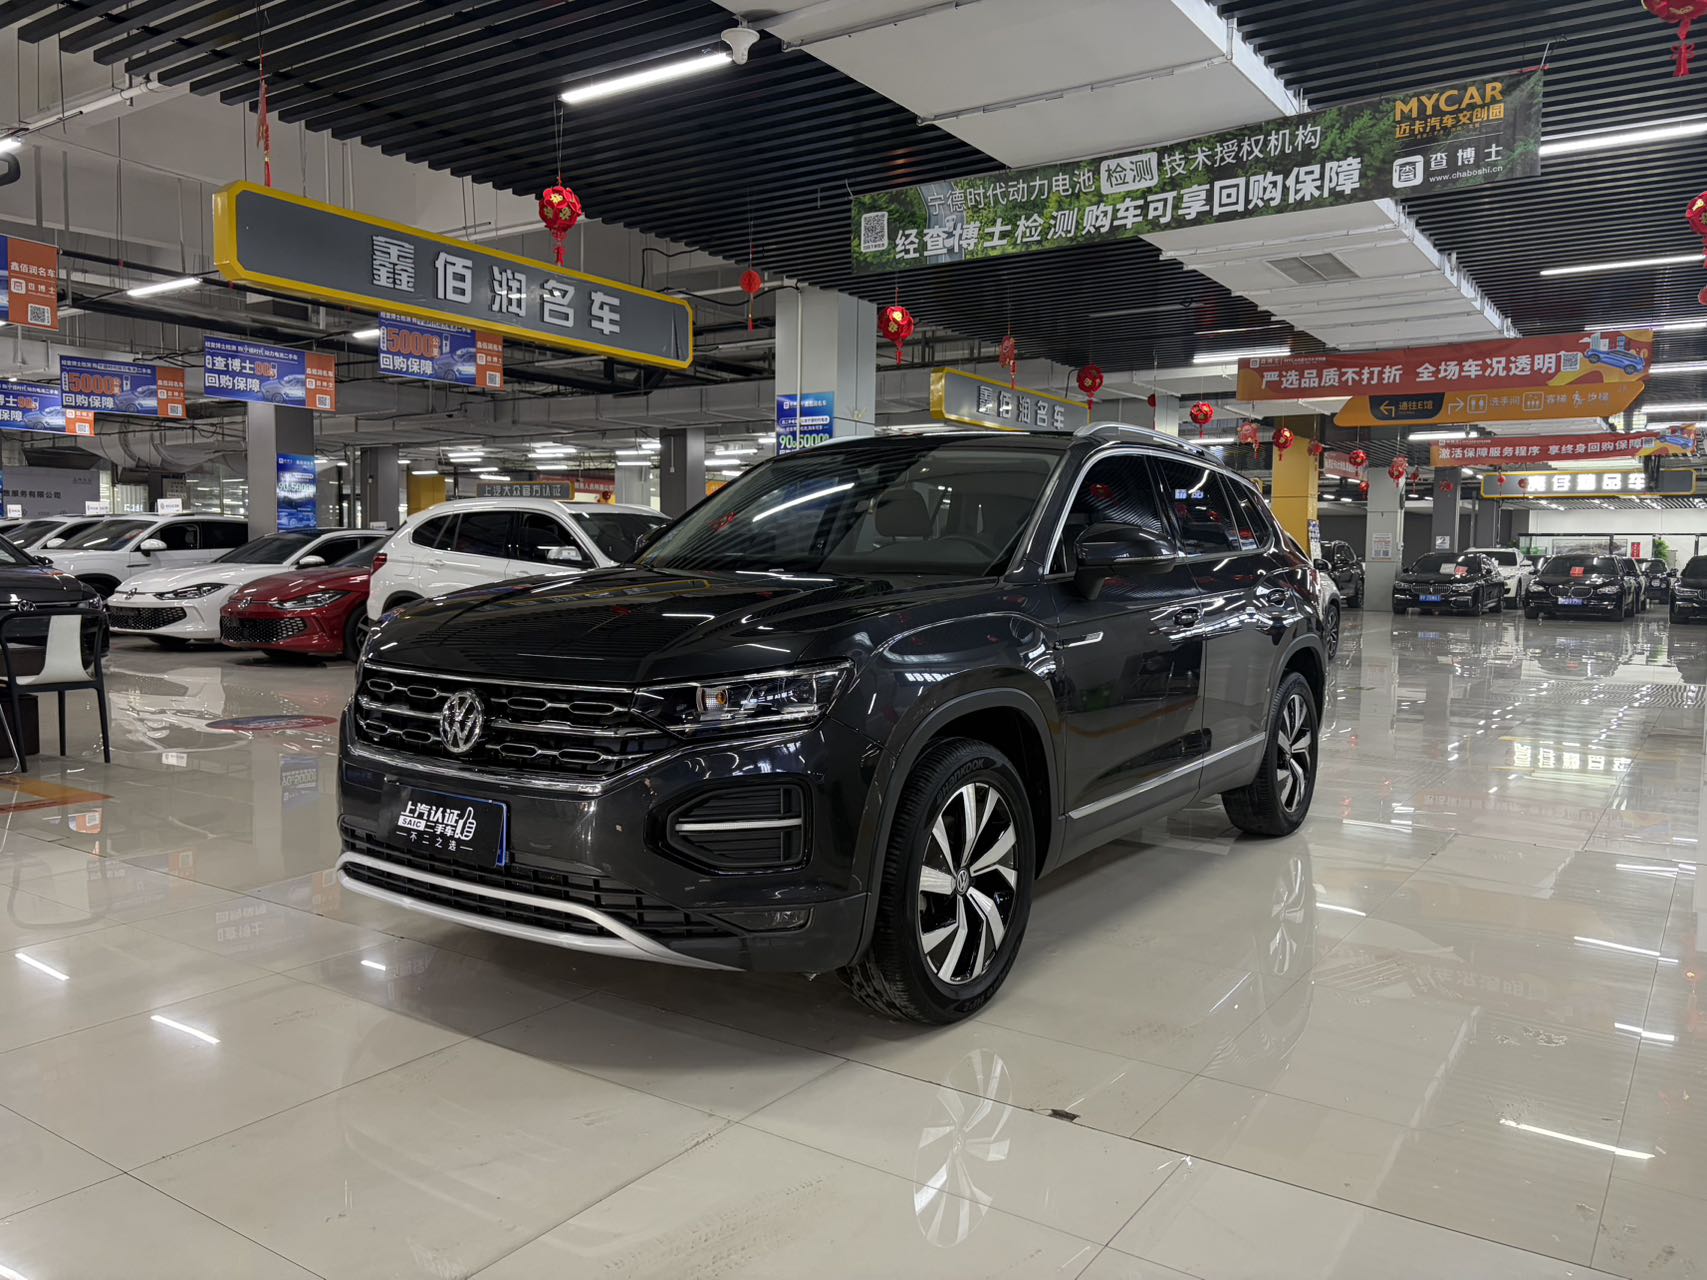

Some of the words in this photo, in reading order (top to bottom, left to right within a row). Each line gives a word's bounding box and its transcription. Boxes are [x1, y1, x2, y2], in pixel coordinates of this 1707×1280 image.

[1395, 82, 1504, 121] MYCAR
[1395, 103, 1504, 139] 迈卡汽车文创园
[1429, 143, 1504, 171] 查博士
[928, 169, 1096, 215] 宁德时代动力电池
[1105, 157, 1154, 188] 检测
[1162, 123, 1321, 178] 技术授权机构
[1429, 165, 1504, 183] www.chaboshi.cn
[372, 235, 621, 335] 鑫佰润名车
[387, 326, 434, 358] 5000
[213, 356, 255, 374] 查博士
[380, 353, 433, 376] 回购保障
[1261, 364, 1403, 389] 严选品质不打折
[1415, 352, 1556, 382] 全场车况透明
[69, 372, 115, 395] 5000
[205, 373, 260, 392] 回购保障
[63, 393, 115, 408] 回购保障
[1439, 446, 1541, 459] 激活保障服务程序
[1548, 438, 1642, 456] 享终身回购保障
[400, 801, 461, 826] 上汽认证
[401, 818, 422, 829] SAIC
[424, 822, 456, 837] 二手车
[410, 831, 457, 852] 不二之选
